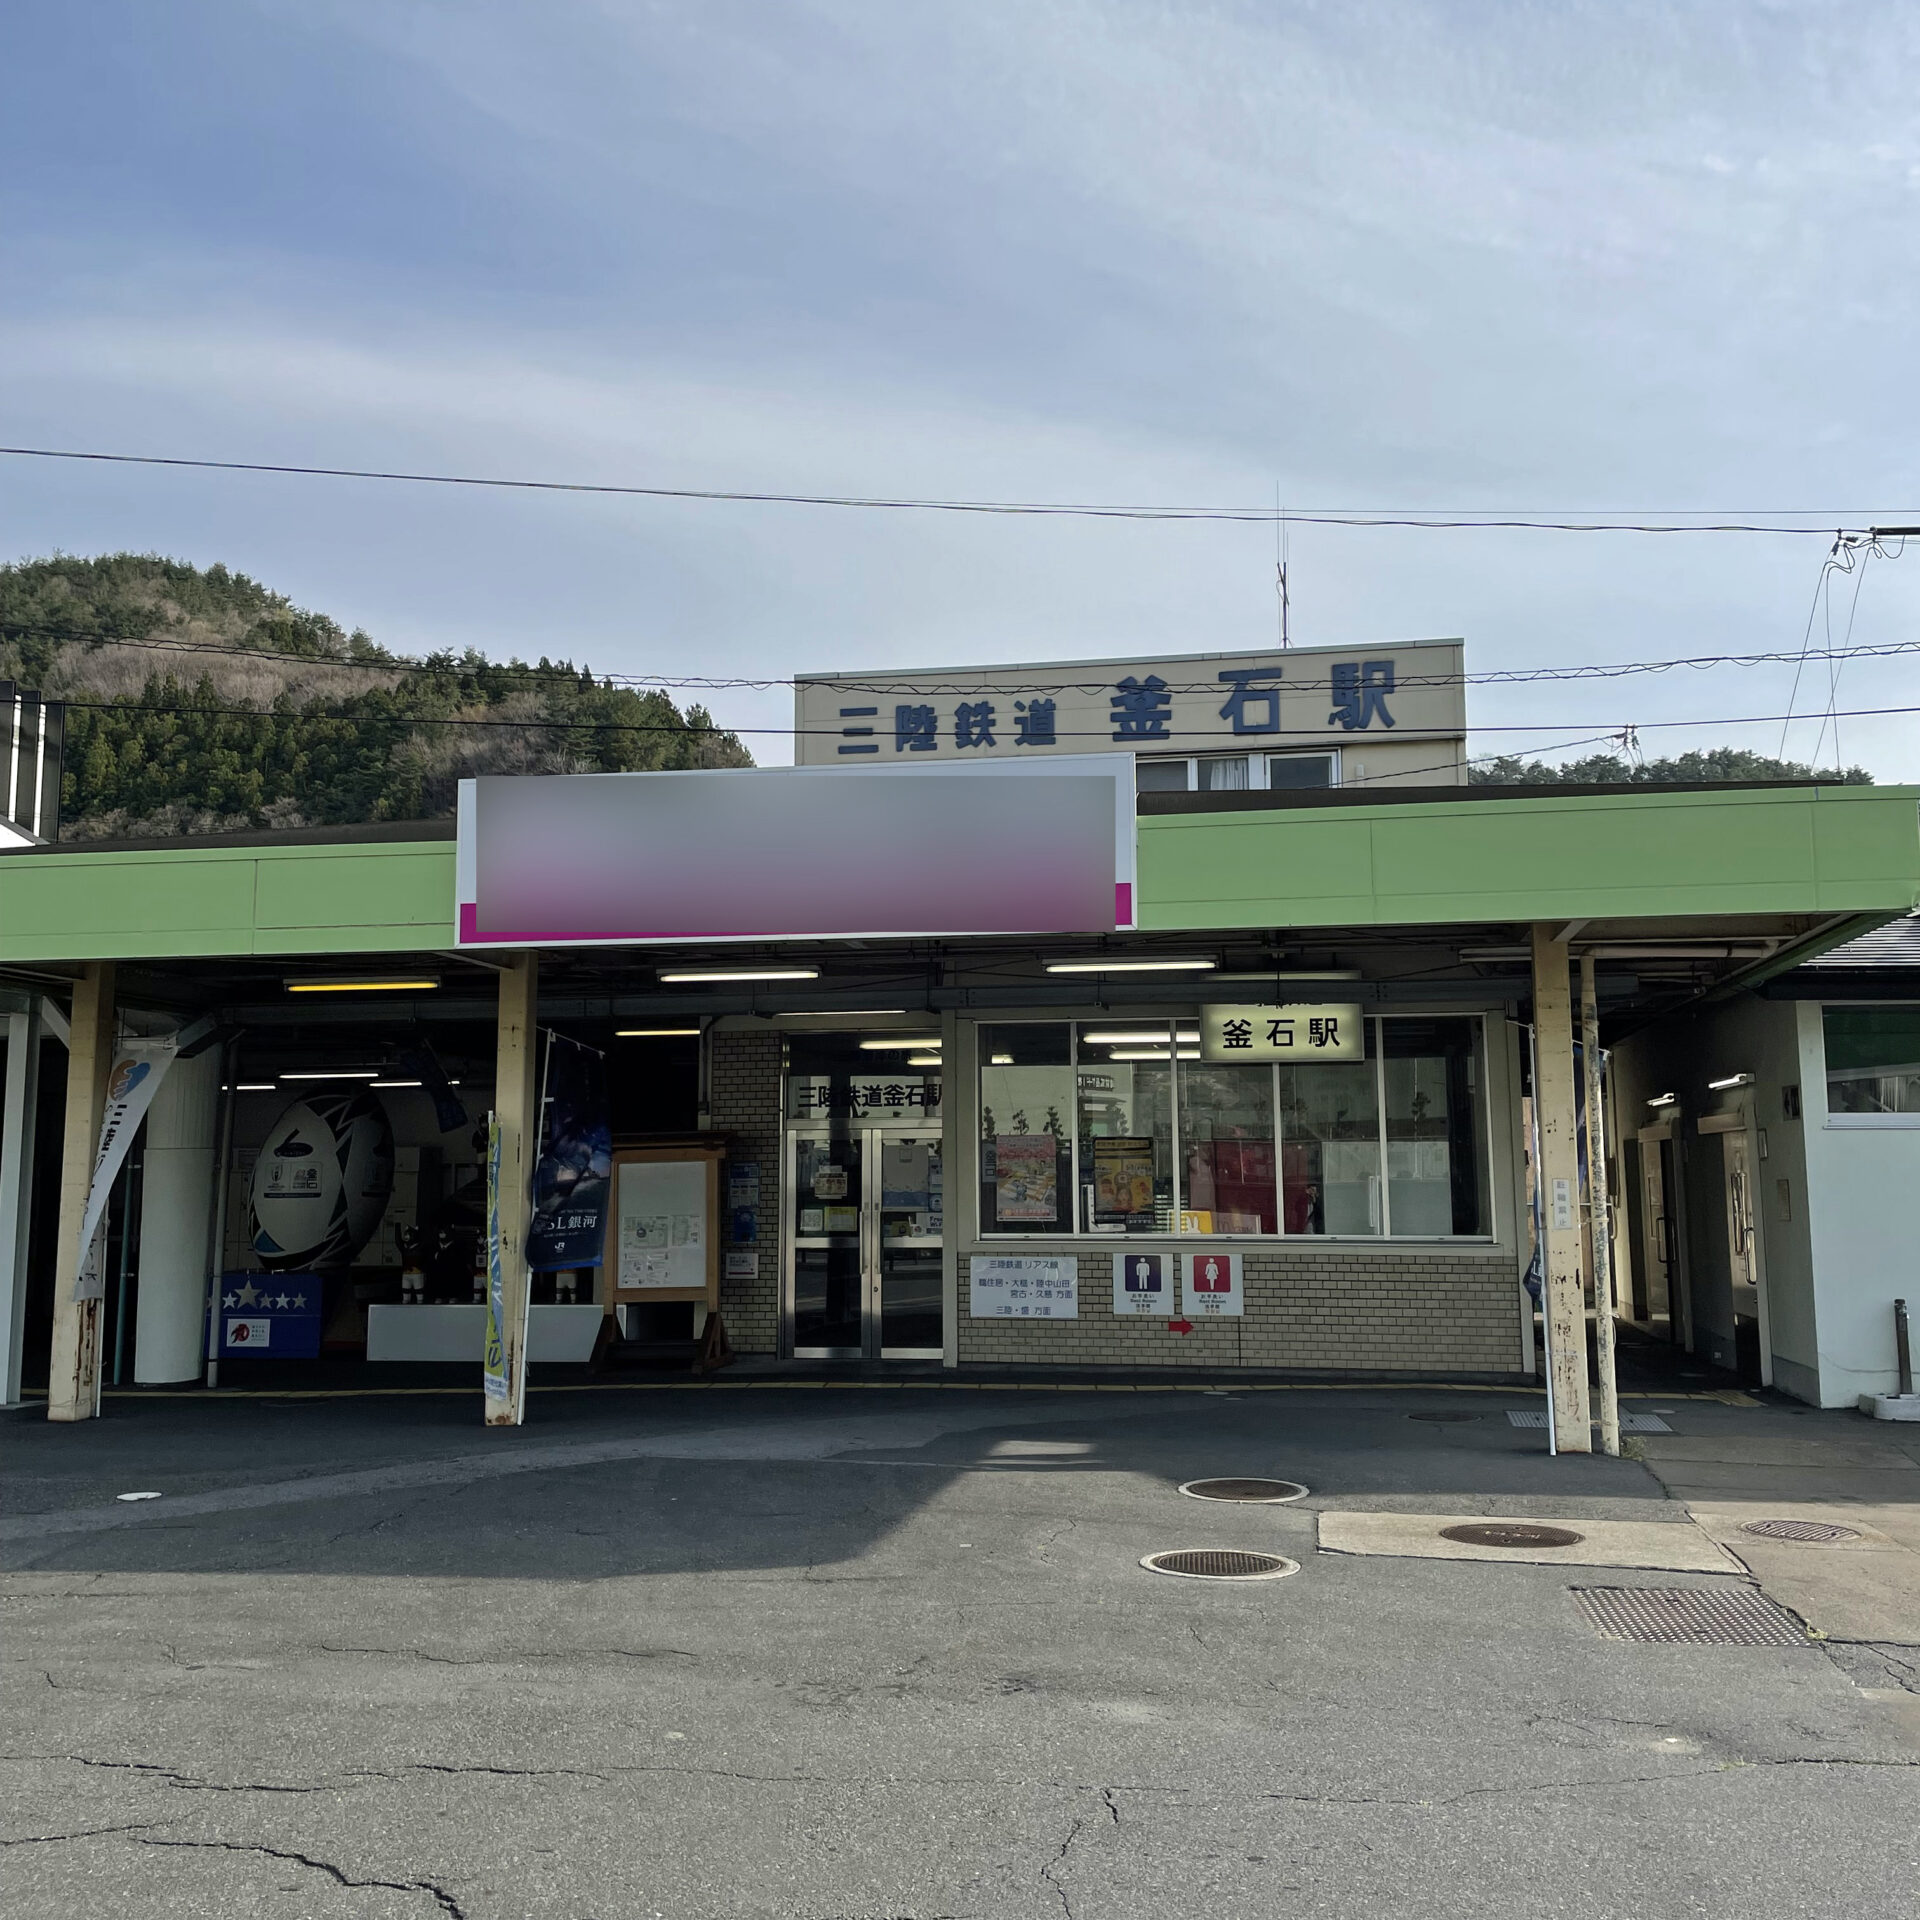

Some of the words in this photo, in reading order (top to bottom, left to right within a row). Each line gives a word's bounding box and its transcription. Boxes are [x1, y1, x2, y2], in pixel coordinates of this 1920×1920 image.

[838, 698, 1057, 755] 三陸鉄道
[1110, 660, 1396, 742] 釜石駅
[1222, 1017, 1340, 1049] 釜石駅
[1055, 1290, 1073, 1299] 方面
[1034, 1306, 1052, 1316] 方面
